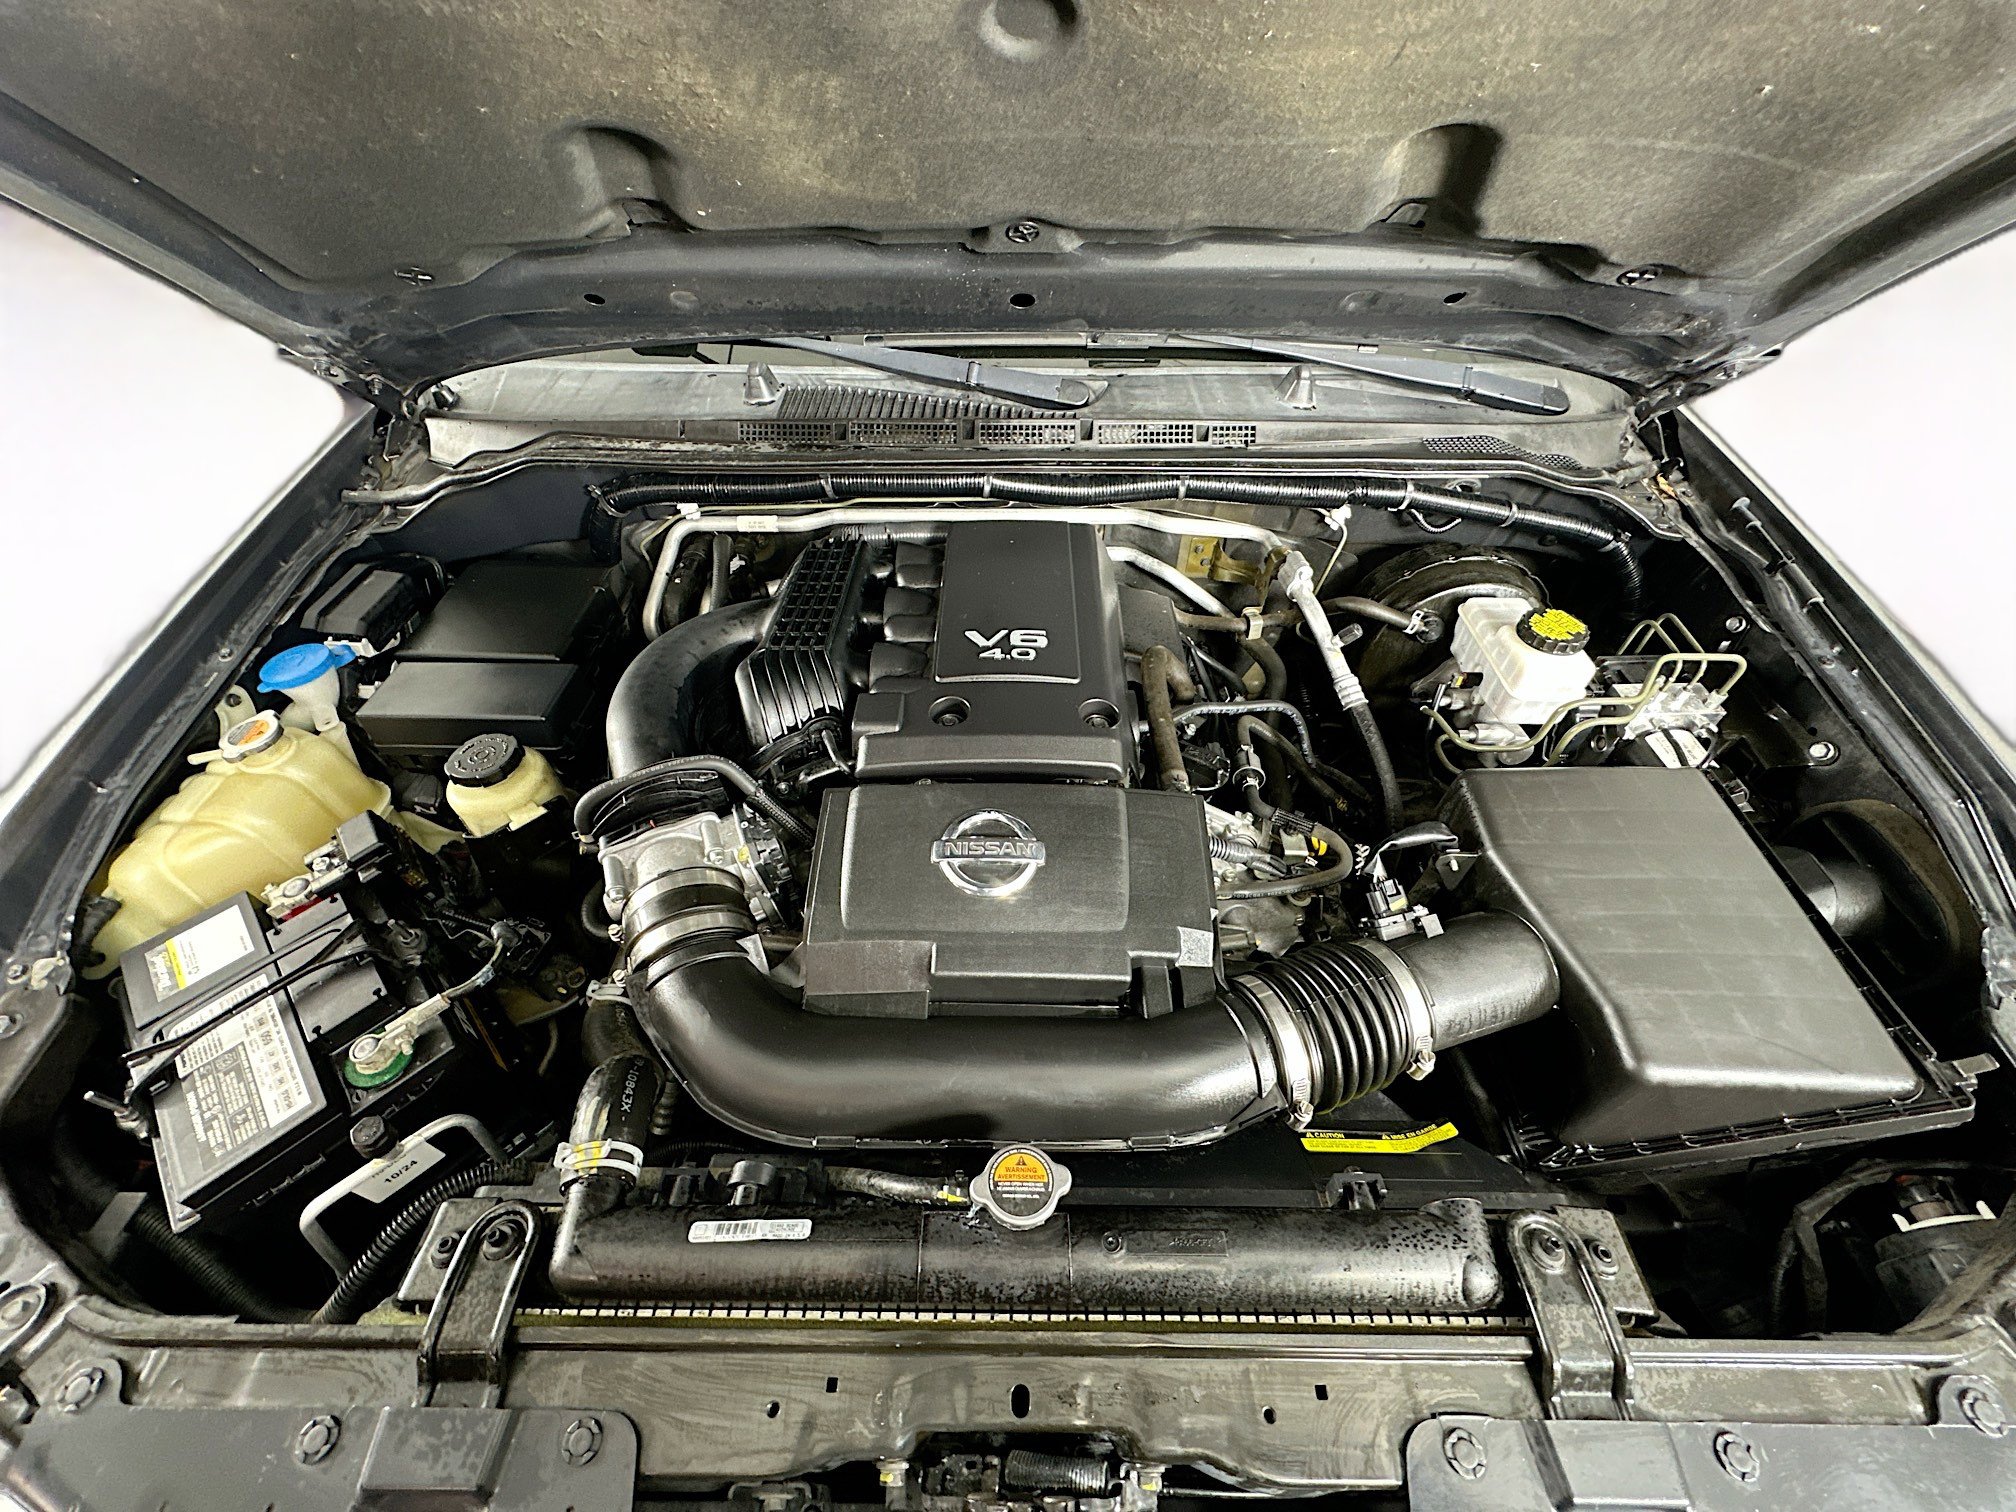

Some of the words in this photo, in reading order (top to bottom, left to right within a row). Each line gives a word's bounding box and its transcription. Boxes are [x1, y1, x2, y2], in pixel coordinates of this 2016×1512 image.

[965, 630, 1048, 648] V6
[979, 648, 1037, 661] 4.0
[945, 841, 1034, 856] NISSAN
[385, 1160, 418, 1183] 10/24
